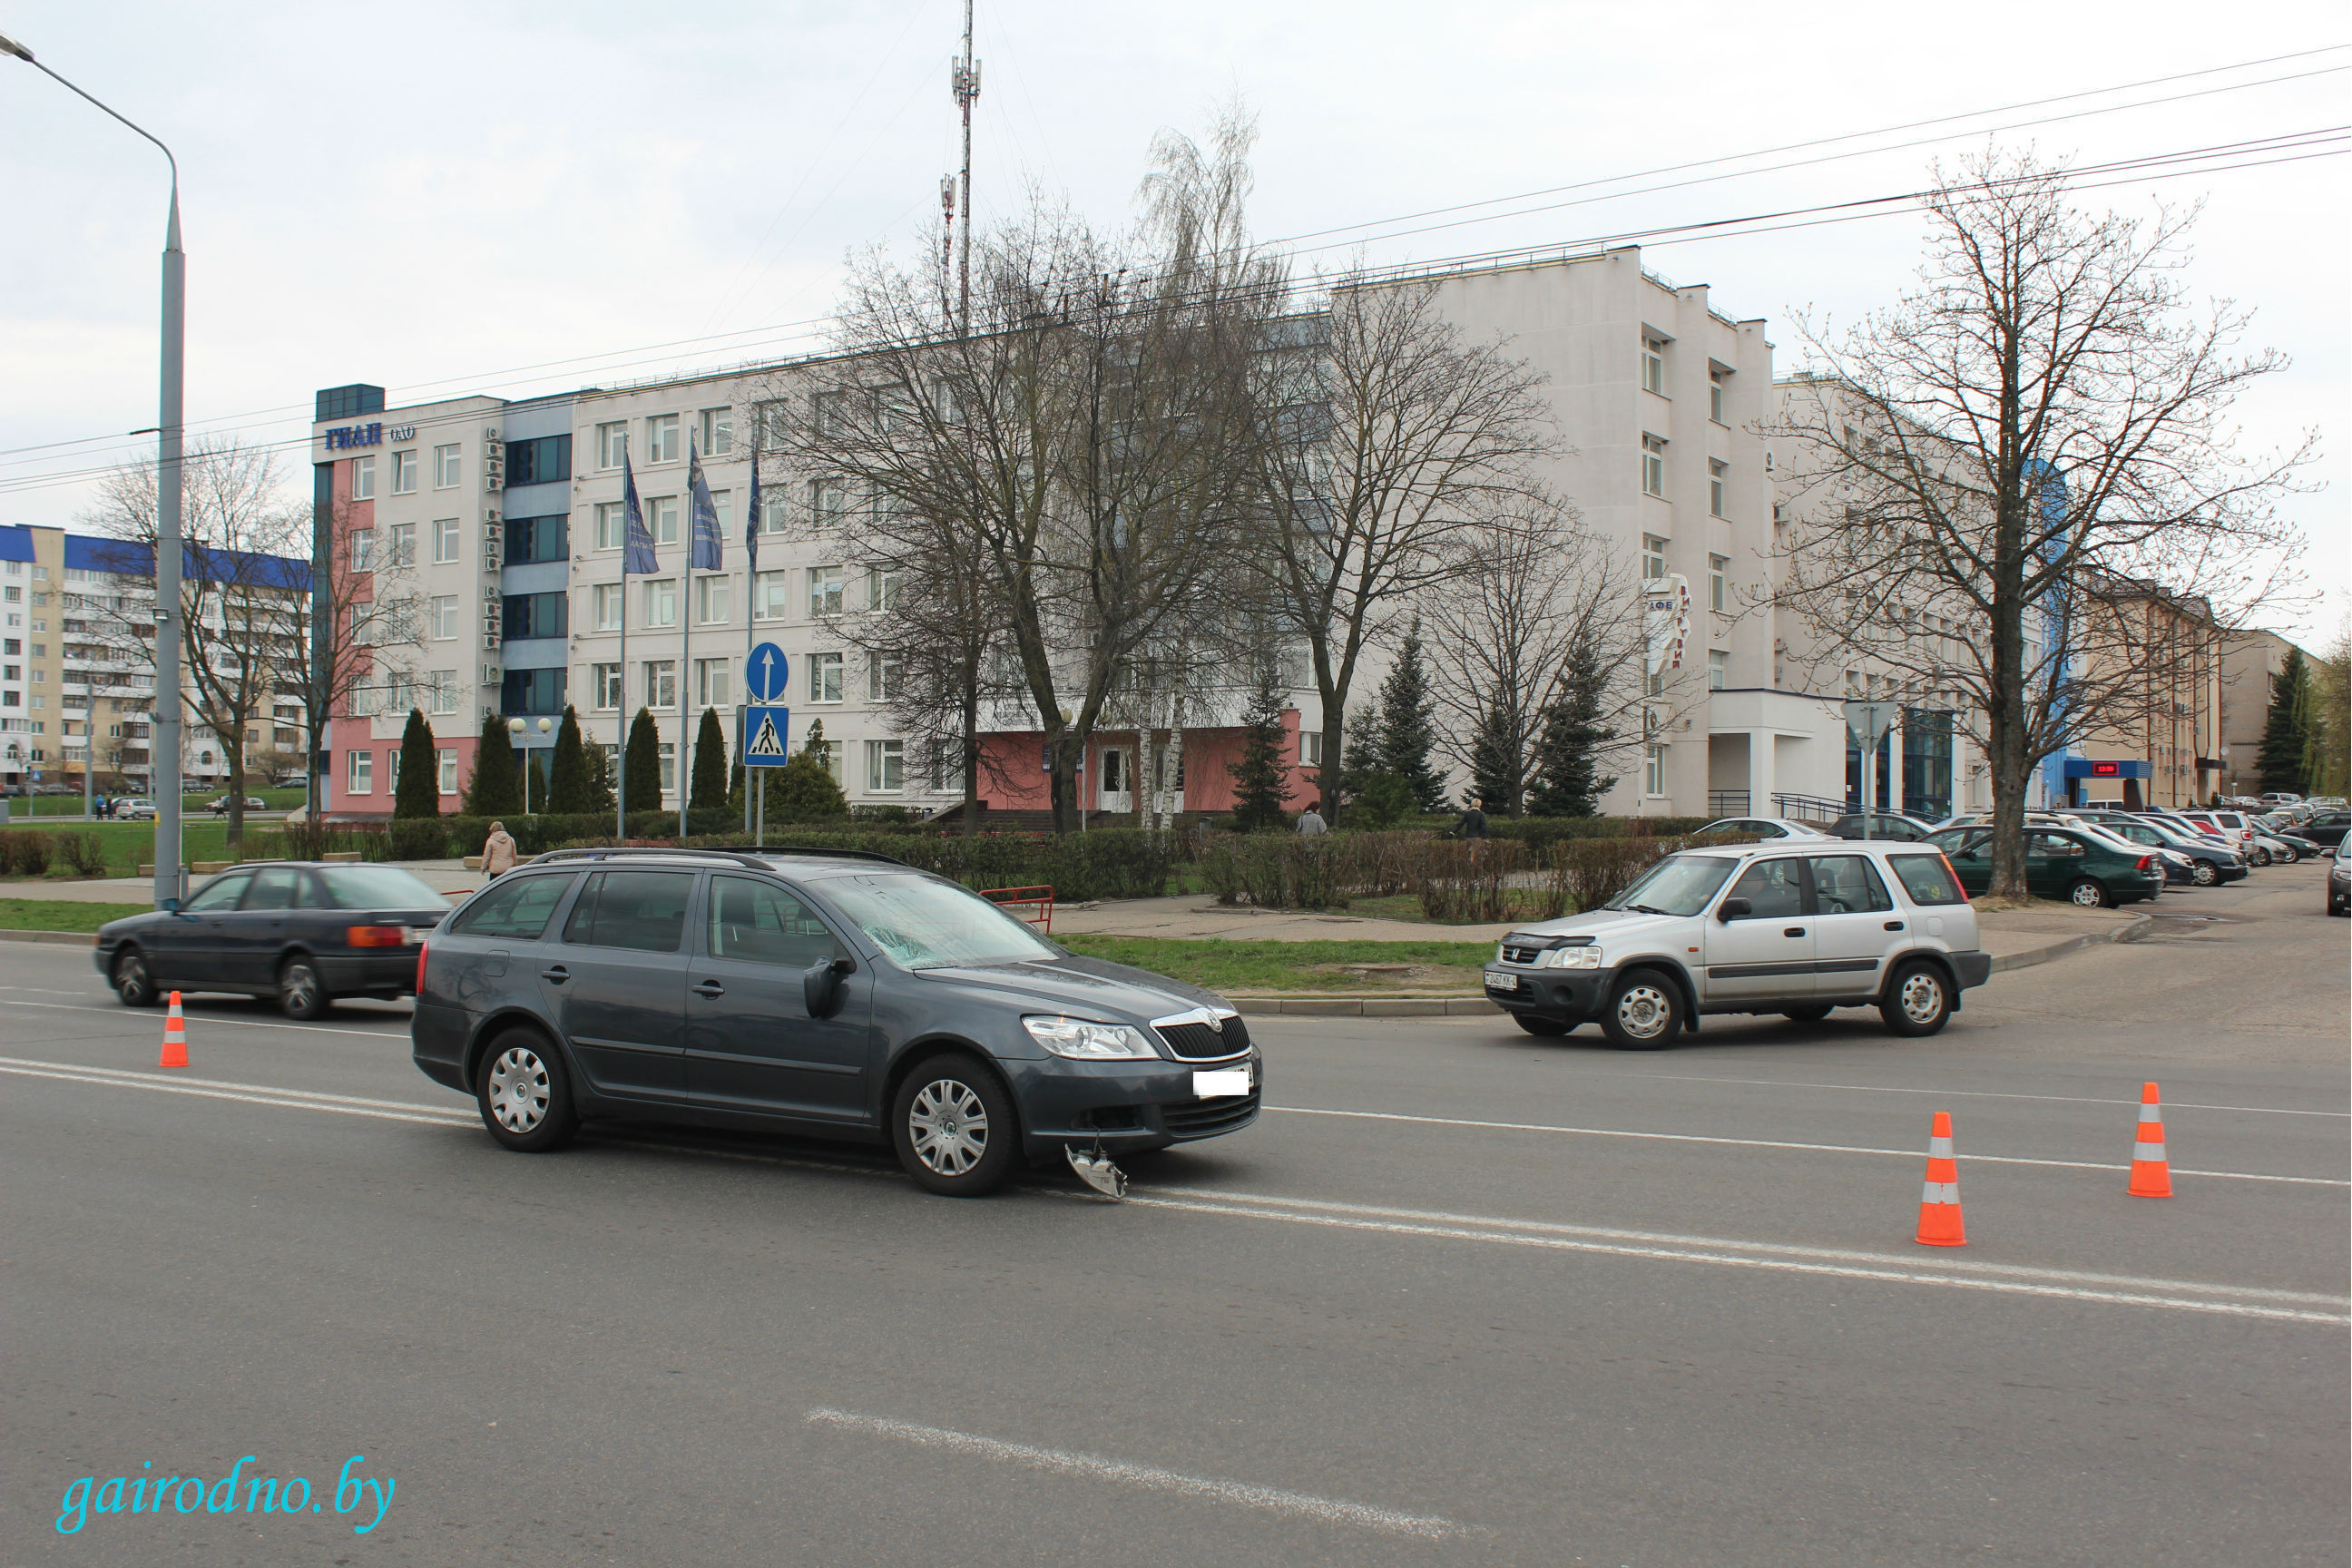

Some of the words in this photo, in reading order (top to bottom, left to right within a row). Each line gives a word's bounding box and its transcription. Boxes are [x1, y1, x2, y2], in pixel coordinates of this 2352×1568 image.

[325, 422, 382, 450] ГИАП
[389, 426, 416, 442] ОАО
[1647, 601, 1673, 612] АФЕ
